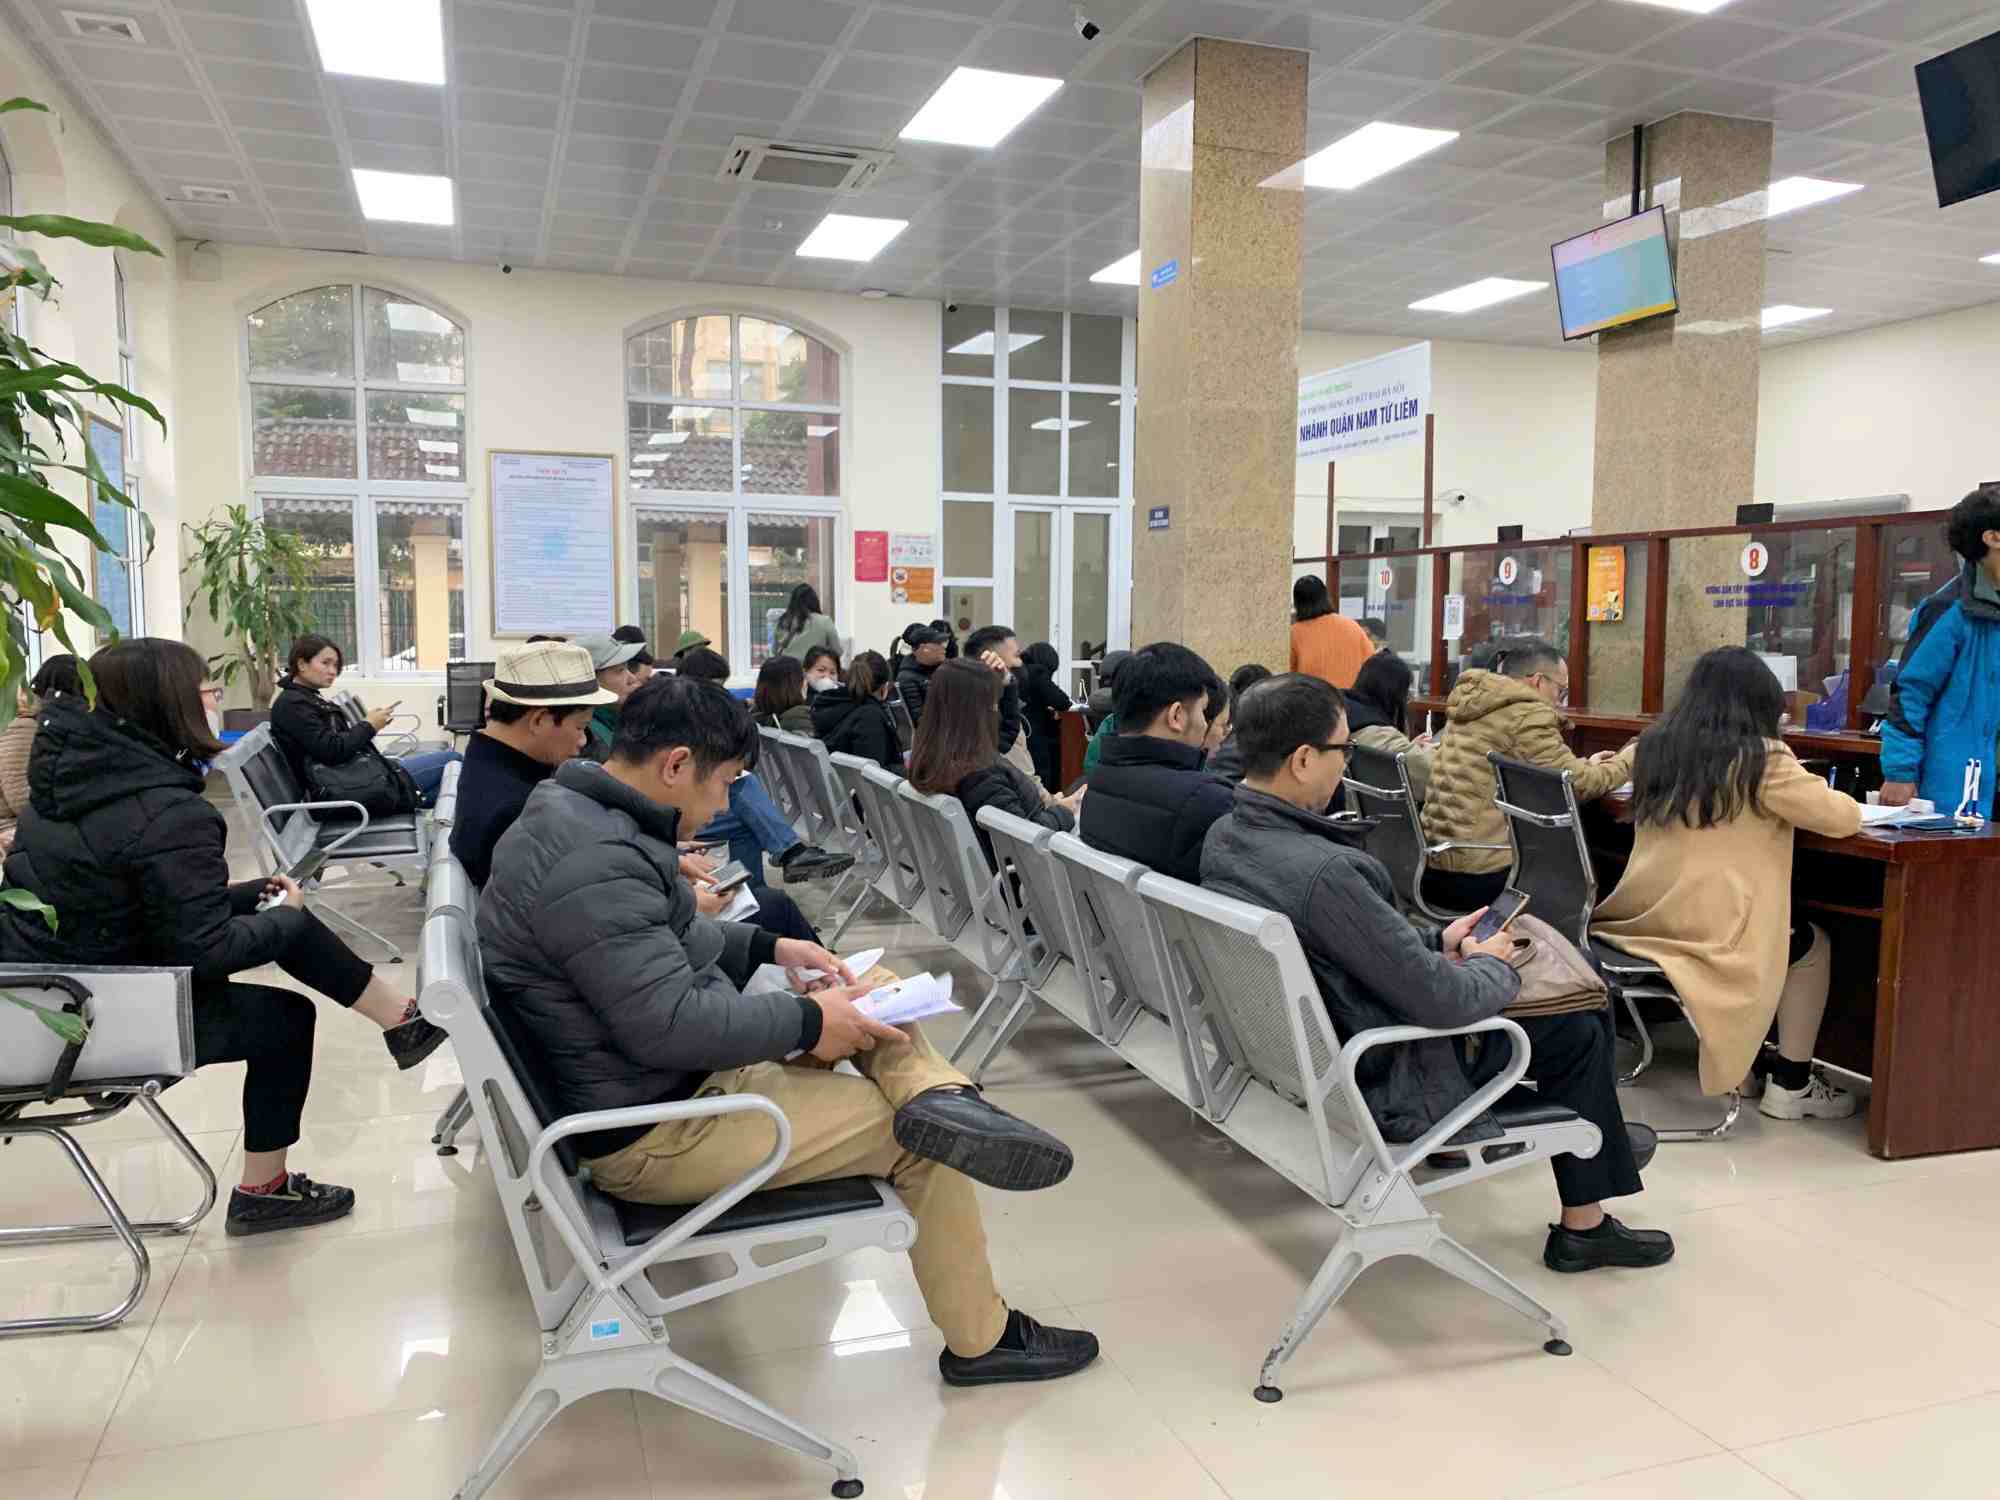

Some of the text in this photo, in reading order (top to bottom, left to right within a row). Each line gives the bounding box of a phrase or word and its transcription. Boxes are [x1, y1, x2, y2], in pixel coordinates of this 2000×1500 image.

[1299, 419, 1328, 441] NHÁNH
[1330, 412, 1354, 438] QUẬN
[1355, 408, 1378, 430] NAM
[1394, 396, 1418, 422] LIÊM
[1749, 547, 1759, 570] 8
[1380, 570, 1390, 585] 10
[1504, 562, 1511, 579] 9
